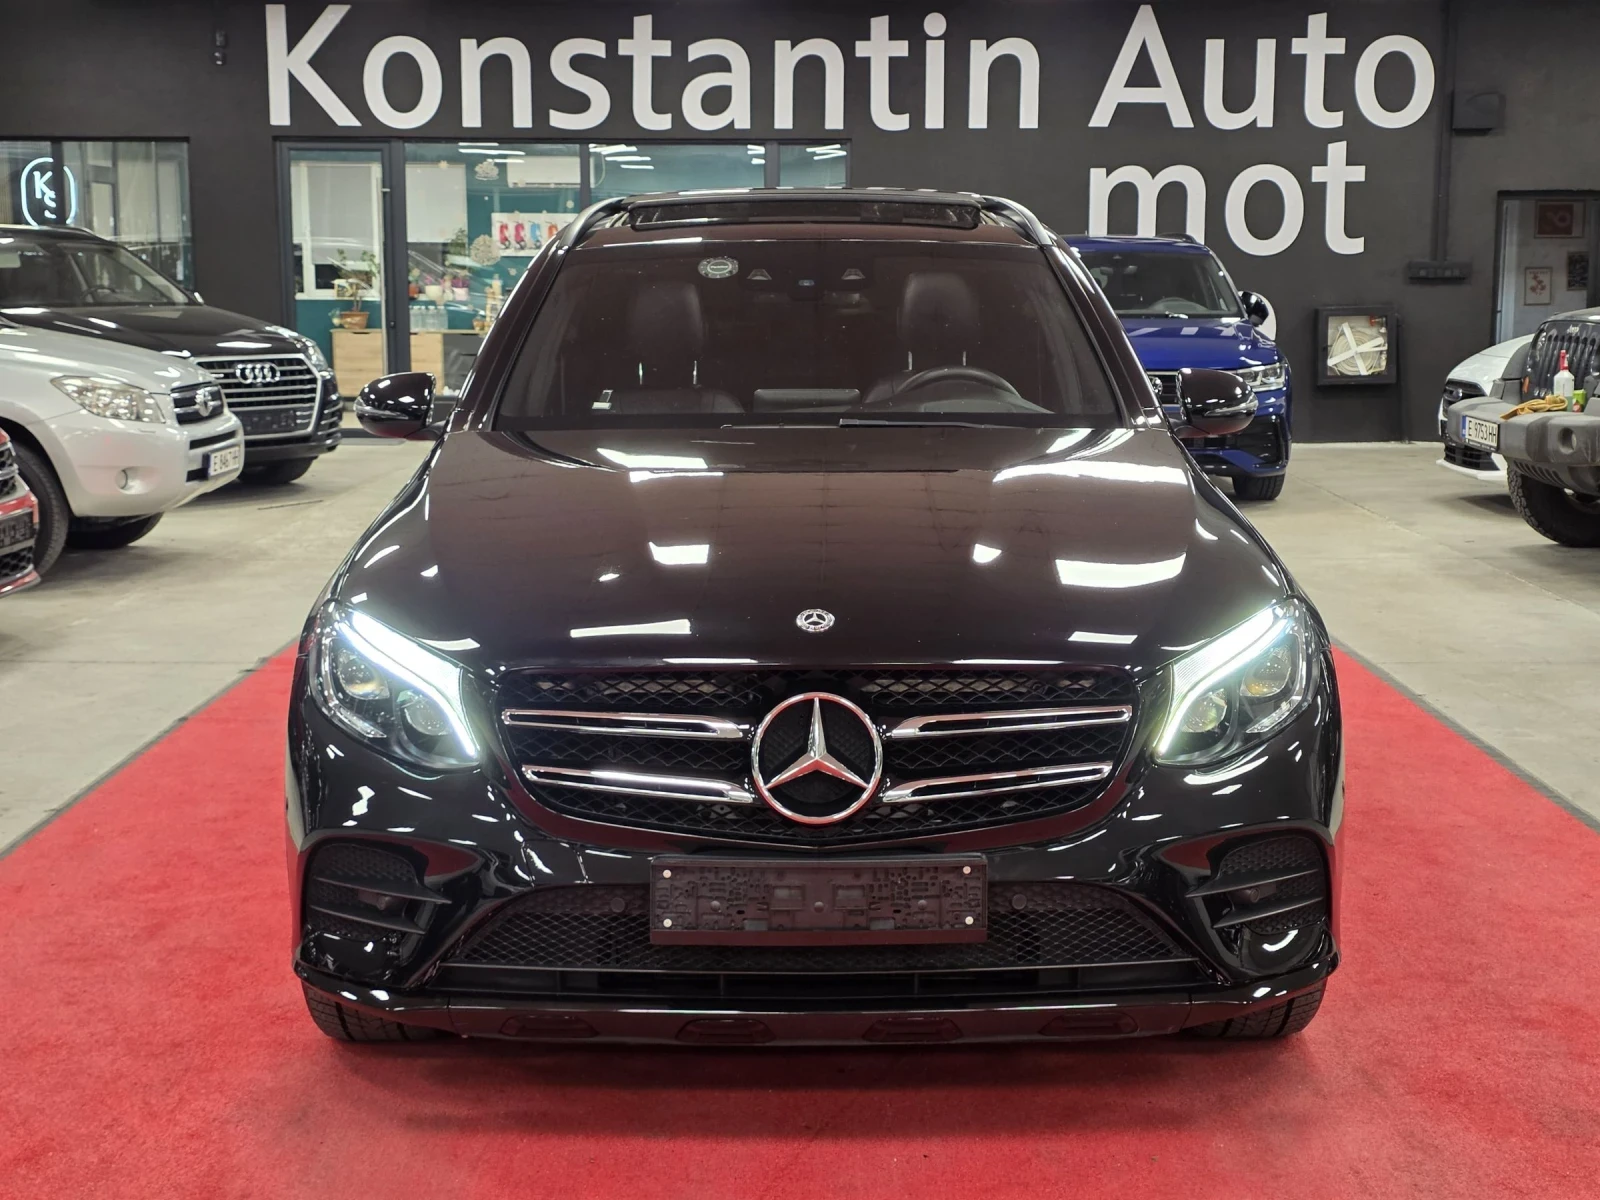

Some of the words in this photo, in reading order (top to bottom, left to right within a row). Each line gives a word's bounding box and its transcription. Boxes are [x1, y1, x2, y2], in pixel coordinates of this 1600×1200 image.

[266, 5, 1040, 130] Konstantin
[1088, 5, 1435, 130] Auto
[1089, 140, 1366, 256] mot
